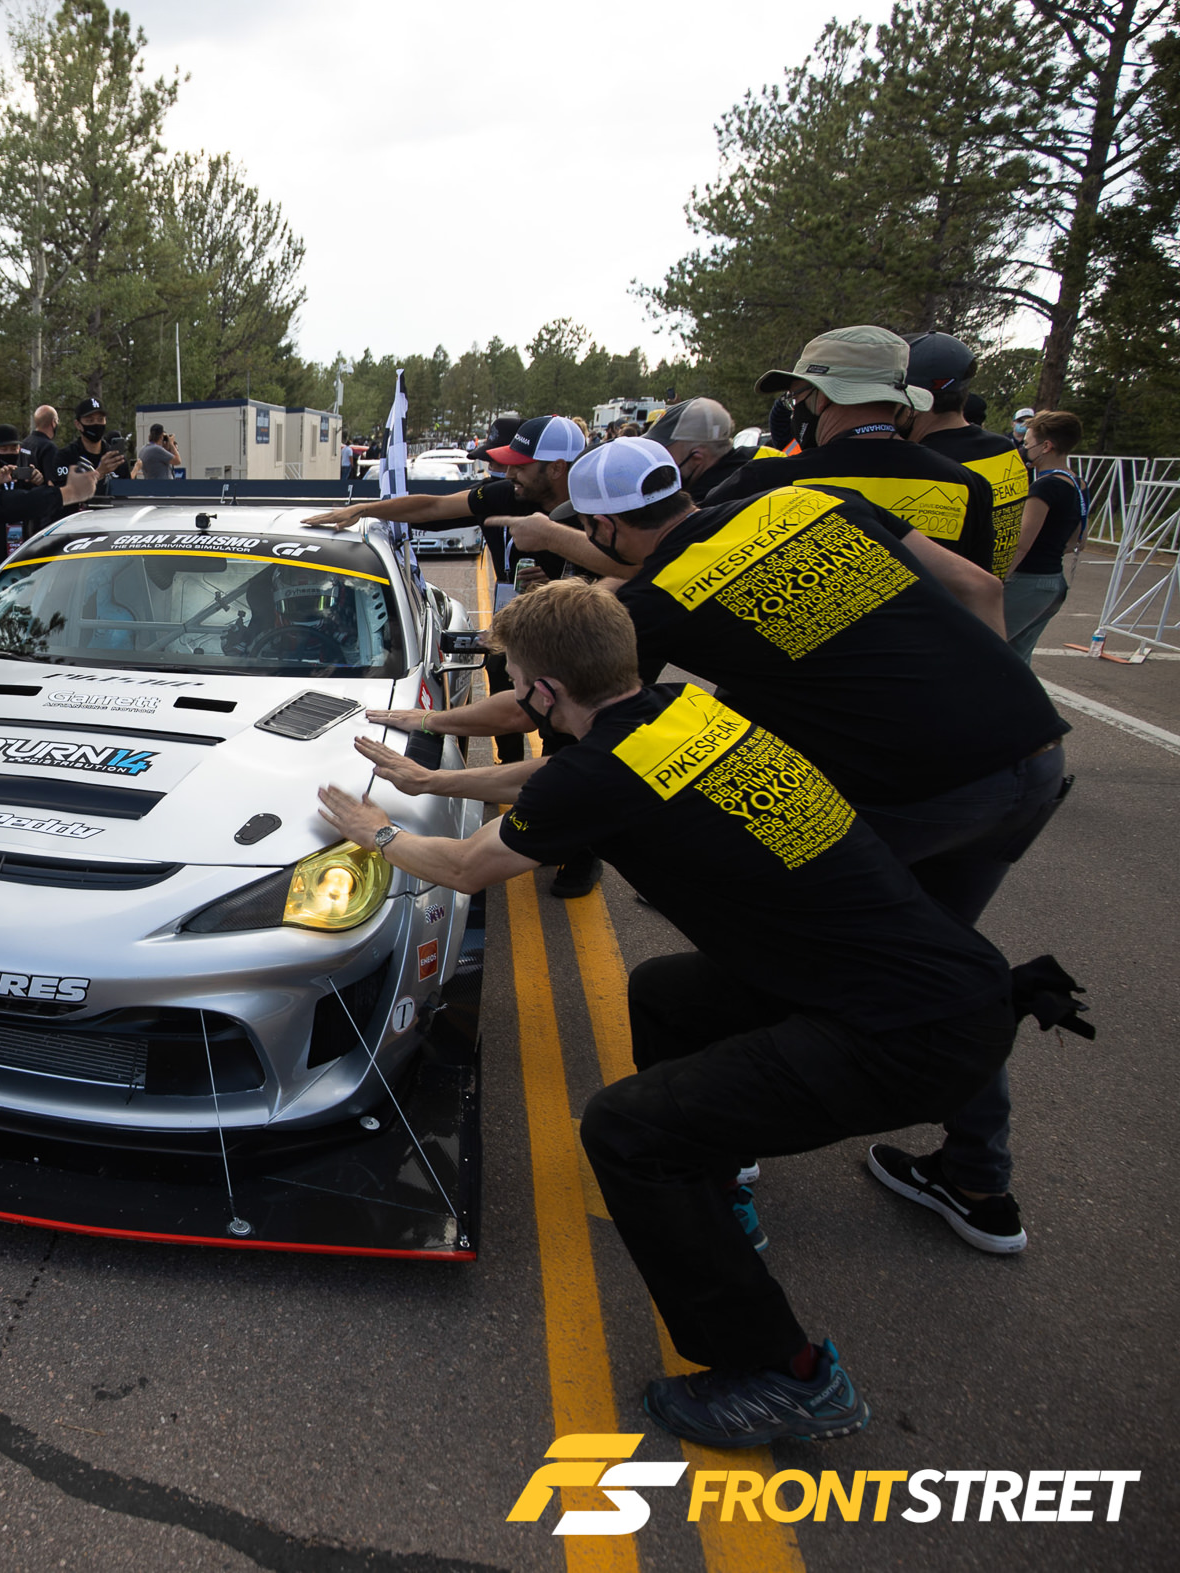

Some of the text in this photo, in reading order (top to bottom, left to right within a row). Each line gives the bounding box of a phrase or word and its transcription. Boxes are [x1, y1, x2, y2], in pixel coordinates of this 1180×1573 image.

[57, 466, 69, 476] 90
[113, 534, 261, 548] GRAN TURISMO
[194, 544, 251, 553] SIMULATOR
[715, 513, 840, 602] PORSCHE OF THE MAINLINE
[750, 543, 819, 594] AUTOSPORT
[818, 524, 855, 547] MOTUL
[720, 516, 846, 606] PORSCHE COLORADO SPRINGS
[734, 526, 863, 618] OPTIMA BATTERIES
[740, 532, 879, 623] YOKOHAMA
[755, 544, 884, 633] PFC BRAKES SWIFT SPRINGS
[760, 549, 890, 639] RDS AUTOMOTIVE GROUP
[769, 613, 812, 642] GUNTHER
[810, 592, 843, 613] WERKS
[842, 574, 871, 595] AETHER
[788, 625, 830, 656] AMERICAN
[830, 593, 880, 628] COLLECTORS
[802, 604, 839, 630] WINDOW
[48, 690, 162, 709] Garrett
[29, 758, 128, 774] DISTRIBUTION
[694, 753, 742, 791] PORSCHE
[736, 744, 749, 758] OF
[703, 758, 747, 797] PORSCHE
[719, 767, 780, 812] OPTIMA
[745, 814, 771, 833] PFC
[770, 787, 806, 815] BRAKES
[753, 818, 784, 841] RDS
[762, 815, 805, 845] GUNTHER
[770, 831, 801, 851] OPERA
[775, 830, 819, 857] WILDLIFE
[784, 832, 827, 866] AMERICAN
[787, 858, 806, 871] FOX
[420, 953, 437, 967] ENEOS
